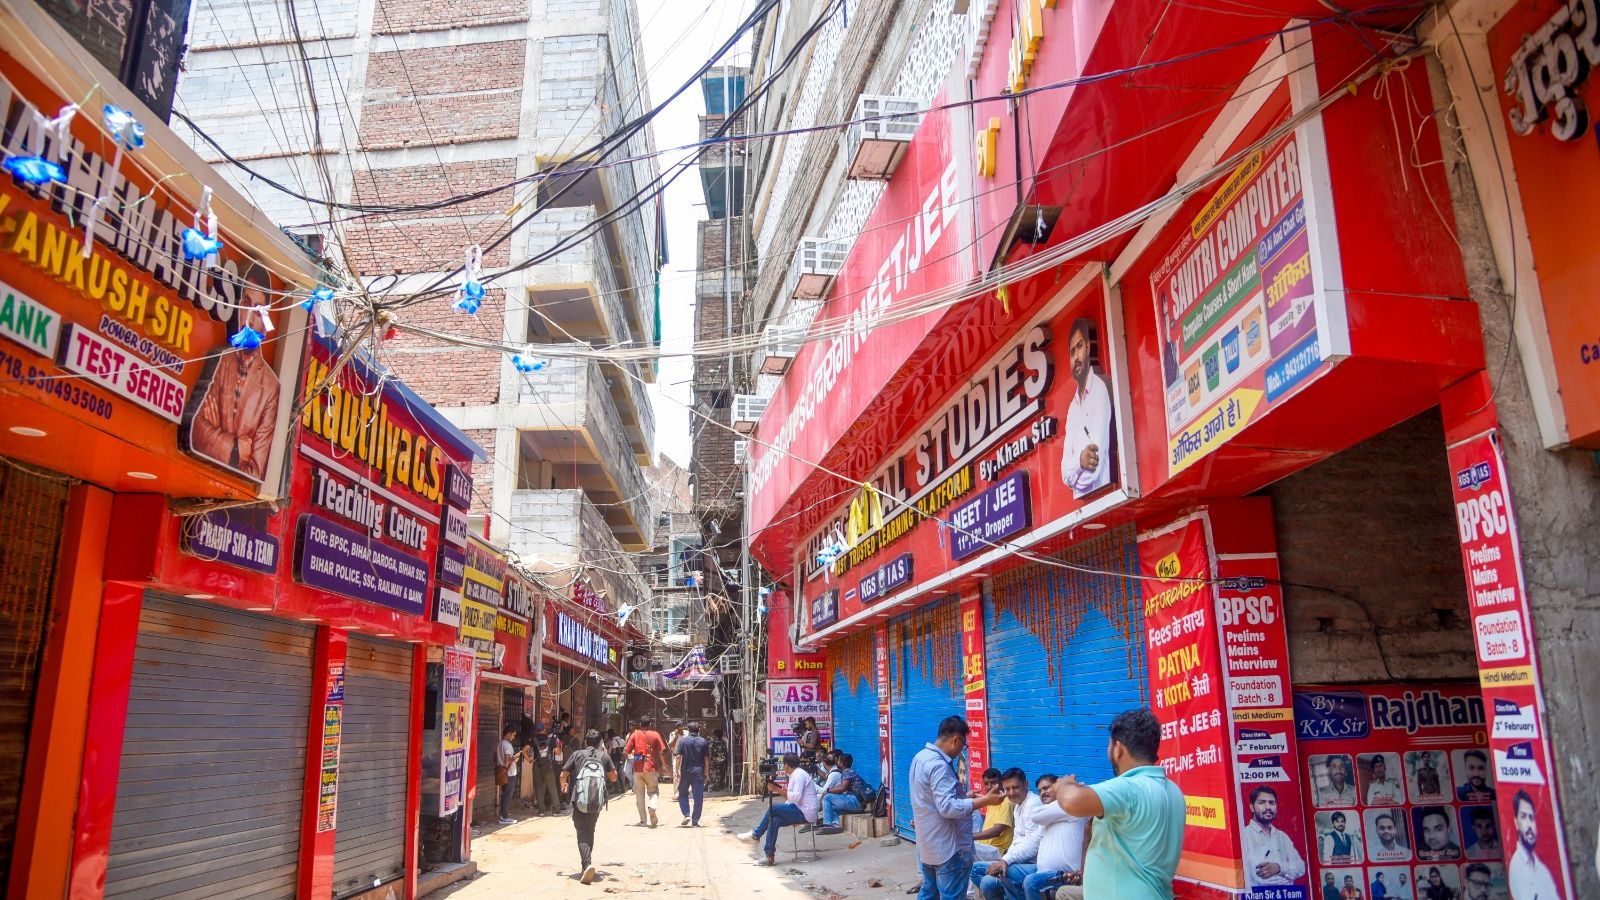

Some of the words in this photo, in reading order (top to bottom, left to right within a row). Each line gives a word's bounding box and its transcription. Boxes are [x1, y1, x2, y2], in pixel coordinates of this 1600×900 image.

[0, 74, 238, 322] ATHEMATICS
[1171, 233, 1217, 321] SAVITRI
[1217, 140, 1301, 271] COMPUTER
[1202, 292, 1223, 323] Courses
[1227, 275, 1243, 299] Short
[1242, 256, 1257, 287] Hand
[1266, 252, 1311, 309] ऑफिस
[101, 315, 138, 349] POWER
[151, 296, 193, 352] SIR
[77, 331, 125, 385] TEST
[126, 364, 184, 418] SERIES
[916, 326, 1048, 486] STUDIES
[1031, 415, 1052, 444] Sir
[1172, 430, 1202, 466] ऑफिस
[1203, 405, 1225, 443] आगे
[1457, 474, 1470, 488] KGS
[1477, 464, 1489, 480] IAS
[317, 469, 384, 539] Teaching
[389, 505, 428, 551] Centre
[849, 536, 876, 568] TRUSTED
[878, 510, 914, 550] LEARNING
[917, 465, 970, 522] PLATFORM
[953, 498, 981, 534] NEET
[993, 478, 1016, 512] JEE
[1456, 490, 1507, 544] BPSC
[448, 514, 468, 540] MATHS
[985, 512, 1014, 540] Dropper
[231, 531, 248, 558] SIR
[247, 540, 254, 561] &
[253, 538, 275, 567] TEAM
[310, 525, 328, 546] FOR:
[329, 535, 350, 557] BPSC,
[351, 541, 372, 561] BIHAR
[372, 550, 399, 574] DAROGA,
[399, 561, 416, 576] BIHAR
[415, 569, 427, 585] SSC,
[1469, 544, 1501, 566] Prelims
[310, 554, 334, 576] BIHAR
[335, 563, 362, 587] POLICE,
[362, 573, 377, 592] SSC,
[377, 578, 403, 597] RAILWAY
[403, 589, 408, 600] &
[408, 591, 423, 604] BANK
[860, 575, 877, 600] KGS
[887, 559, 905, 585] IAS
[1472, 567, 1498, 587] Mains
[1144, 571, 1206, 618] AFFORDABLE
[1475, 586, 1516, 607] Interview
[440, 597, 460, 619] ENGLISH
[1218, 595, 1275, 626] BPSC
[1149, 622, 1172, 650] Fees
[1171, 614, 1183, 639] के
[1182, 608, 1206, 634] साथ
[1226, 631, 1266, 643] Prelims
[1478, 618, 1519, 636] Foundation
[1227, 645, 1259, 657] Mains
[1487, 642, 1507, 656] Batch
[1512, 639, 1519, 653] 8
[795, 660, 824, 670] Khan
[1158, 643, 1201, 681] PATNA
[1229, 656, 1278, 671] Interview
[1230, 679, 1277, 691] Foundation
[1484, 672, 1500, 683] Hindi
[1500, 669, 1528, 682] Medium
[1156, 689, 1165, 709] में
[1163, 679, 1192, 707] KOTA
[1191, 672, 1211, 698] जैसी
[1238, 692, 1262, 704] Batch
[1268, 692, 1275, 703] 8
[773, 705, 790, 714] MATH
[1251, 710, 1284, 721] Medium
[1311, 695, 1335, 714] By
[1179, 717, 1190, 737] &
[1189, 711, 1210, 734] JEE
[1209, 708, 1222, 728] की
[1339, 716, 1365, 735] Sir
[1504, 722, 1534, 732] February
[1249, 742, 1286, 753] February
[1512, 747, 1527, 758] Time
[1257, 758, 1273, 766] Time
[1500, 766, 1519, 777] 12:00
[1519, 766, 1531, 777] PM
[1240, 771, 1264, 780] 12:00
[1265, 771, 1280, 780] PM
[1201, 804, 1217, 819] Open
[1245, 891, 1264, 900] Khan
[1264, 889, 1275, 899] Sir
[1275, 889, 1281, 899] &
[1282, 889, 1302, 899] Team
